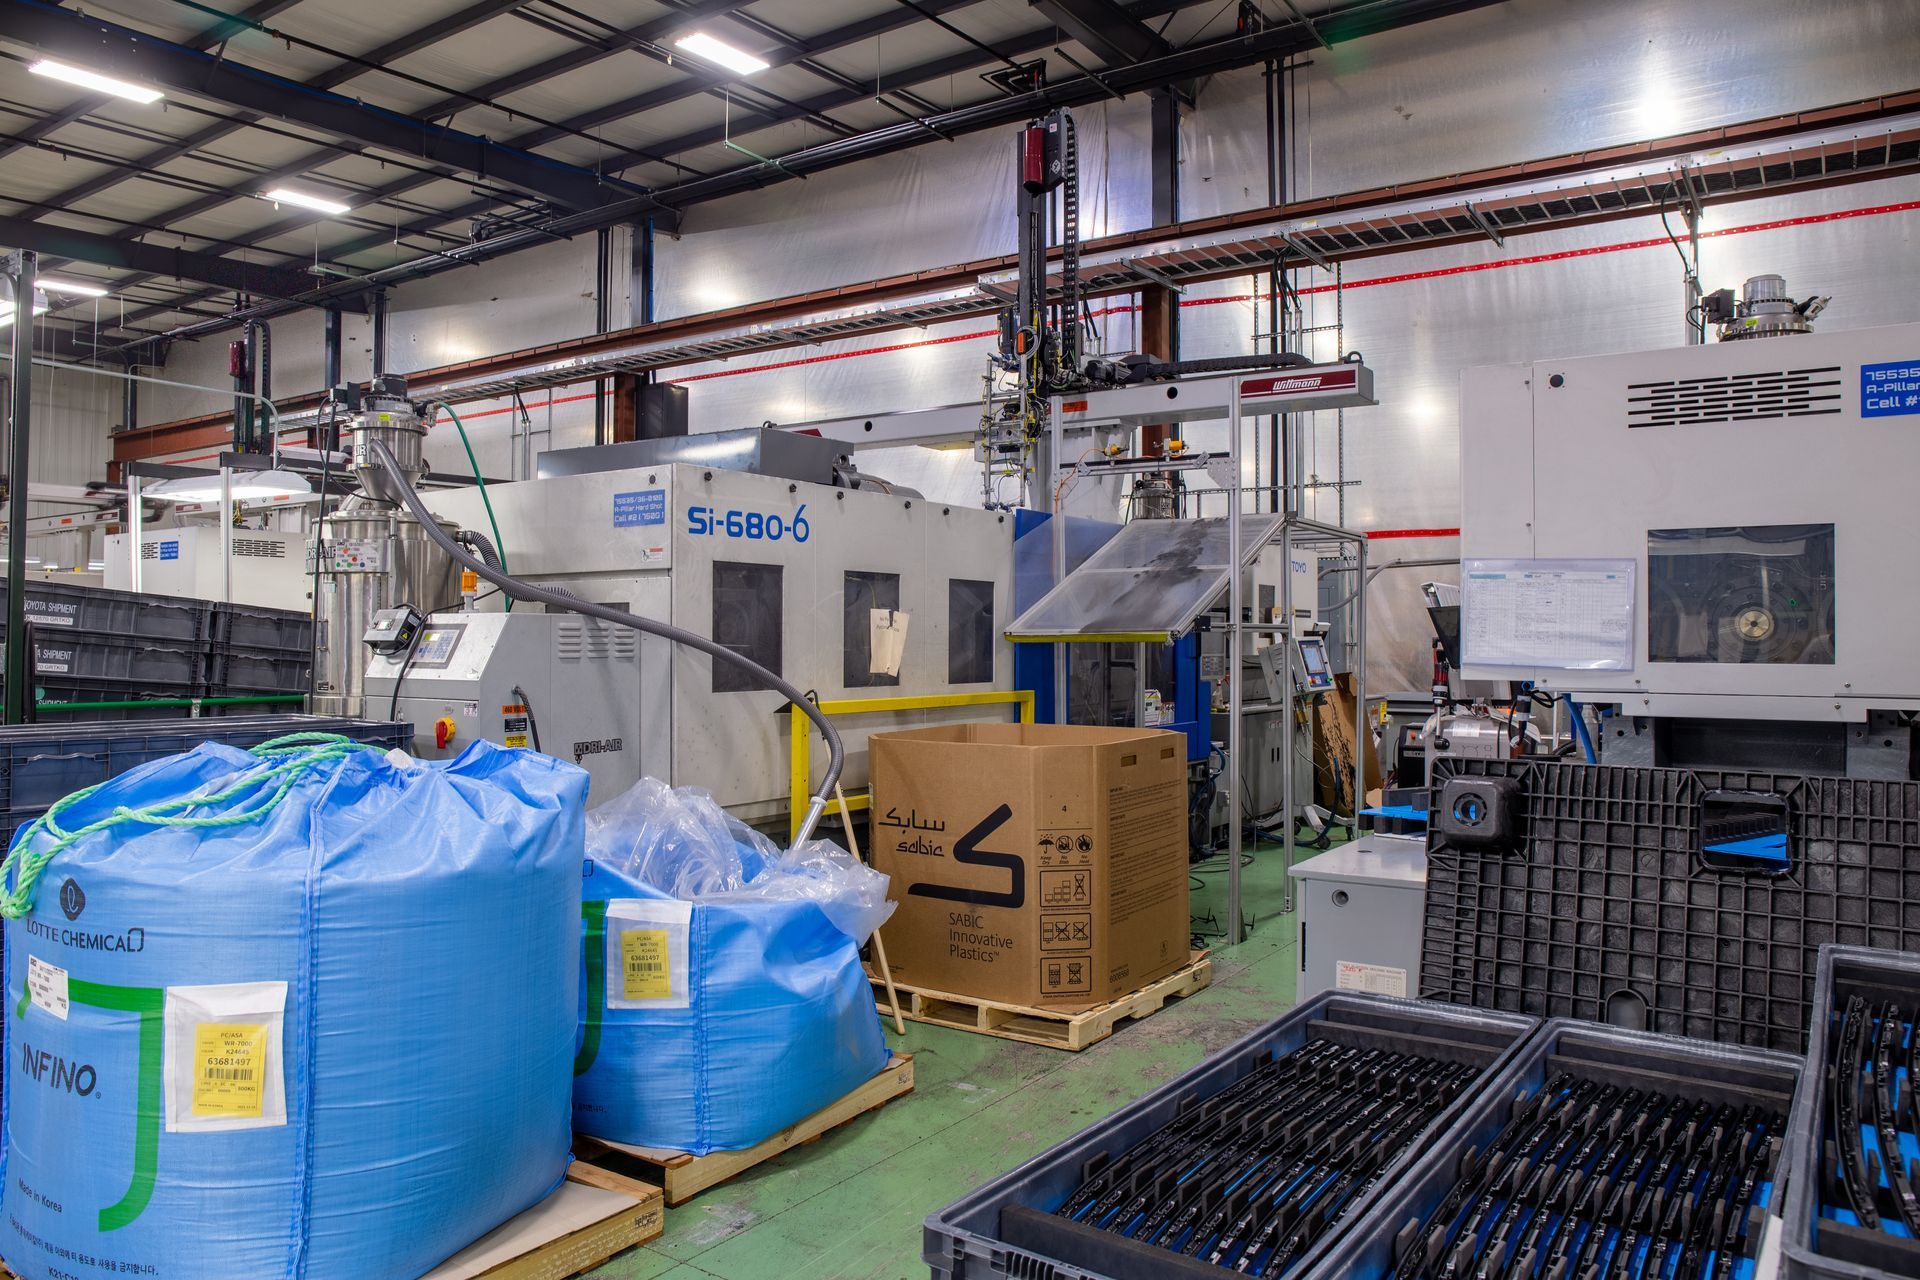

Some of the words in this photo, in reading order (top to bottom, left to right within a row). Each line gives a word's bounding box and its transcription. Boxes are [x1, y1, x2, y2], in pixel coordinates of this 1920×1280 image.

[1273, 377, 1322, 391] Wittmann
[1867, 396, 1900, 409] Cell
[688, 504, 809, 543] Si-680-6
[1291, 561, 1307, 573] TOYO
[48, 602, 77, 614] SHIPMENT
[43, 650, 72, 661] SHIPMENT
[582, 738, 623, 755] DRI-AIR
[896, 836, 945, 857] sabic
[950, 912, 984, 929] SABIC
[27, 919, 59, 942] LOTTE
[62, 927, 145, 952] CHEMICAL
[950, 928, 1013, 949] Innovative
[208, 1057, 251, 1066] 63681497
[19, 1178, 33, 1198] Made
[34, 1189, 40, 1202] in
[41, 1194, 63, 1213] Korea
[119, 1261, 159, 1276] 금지합니다.
